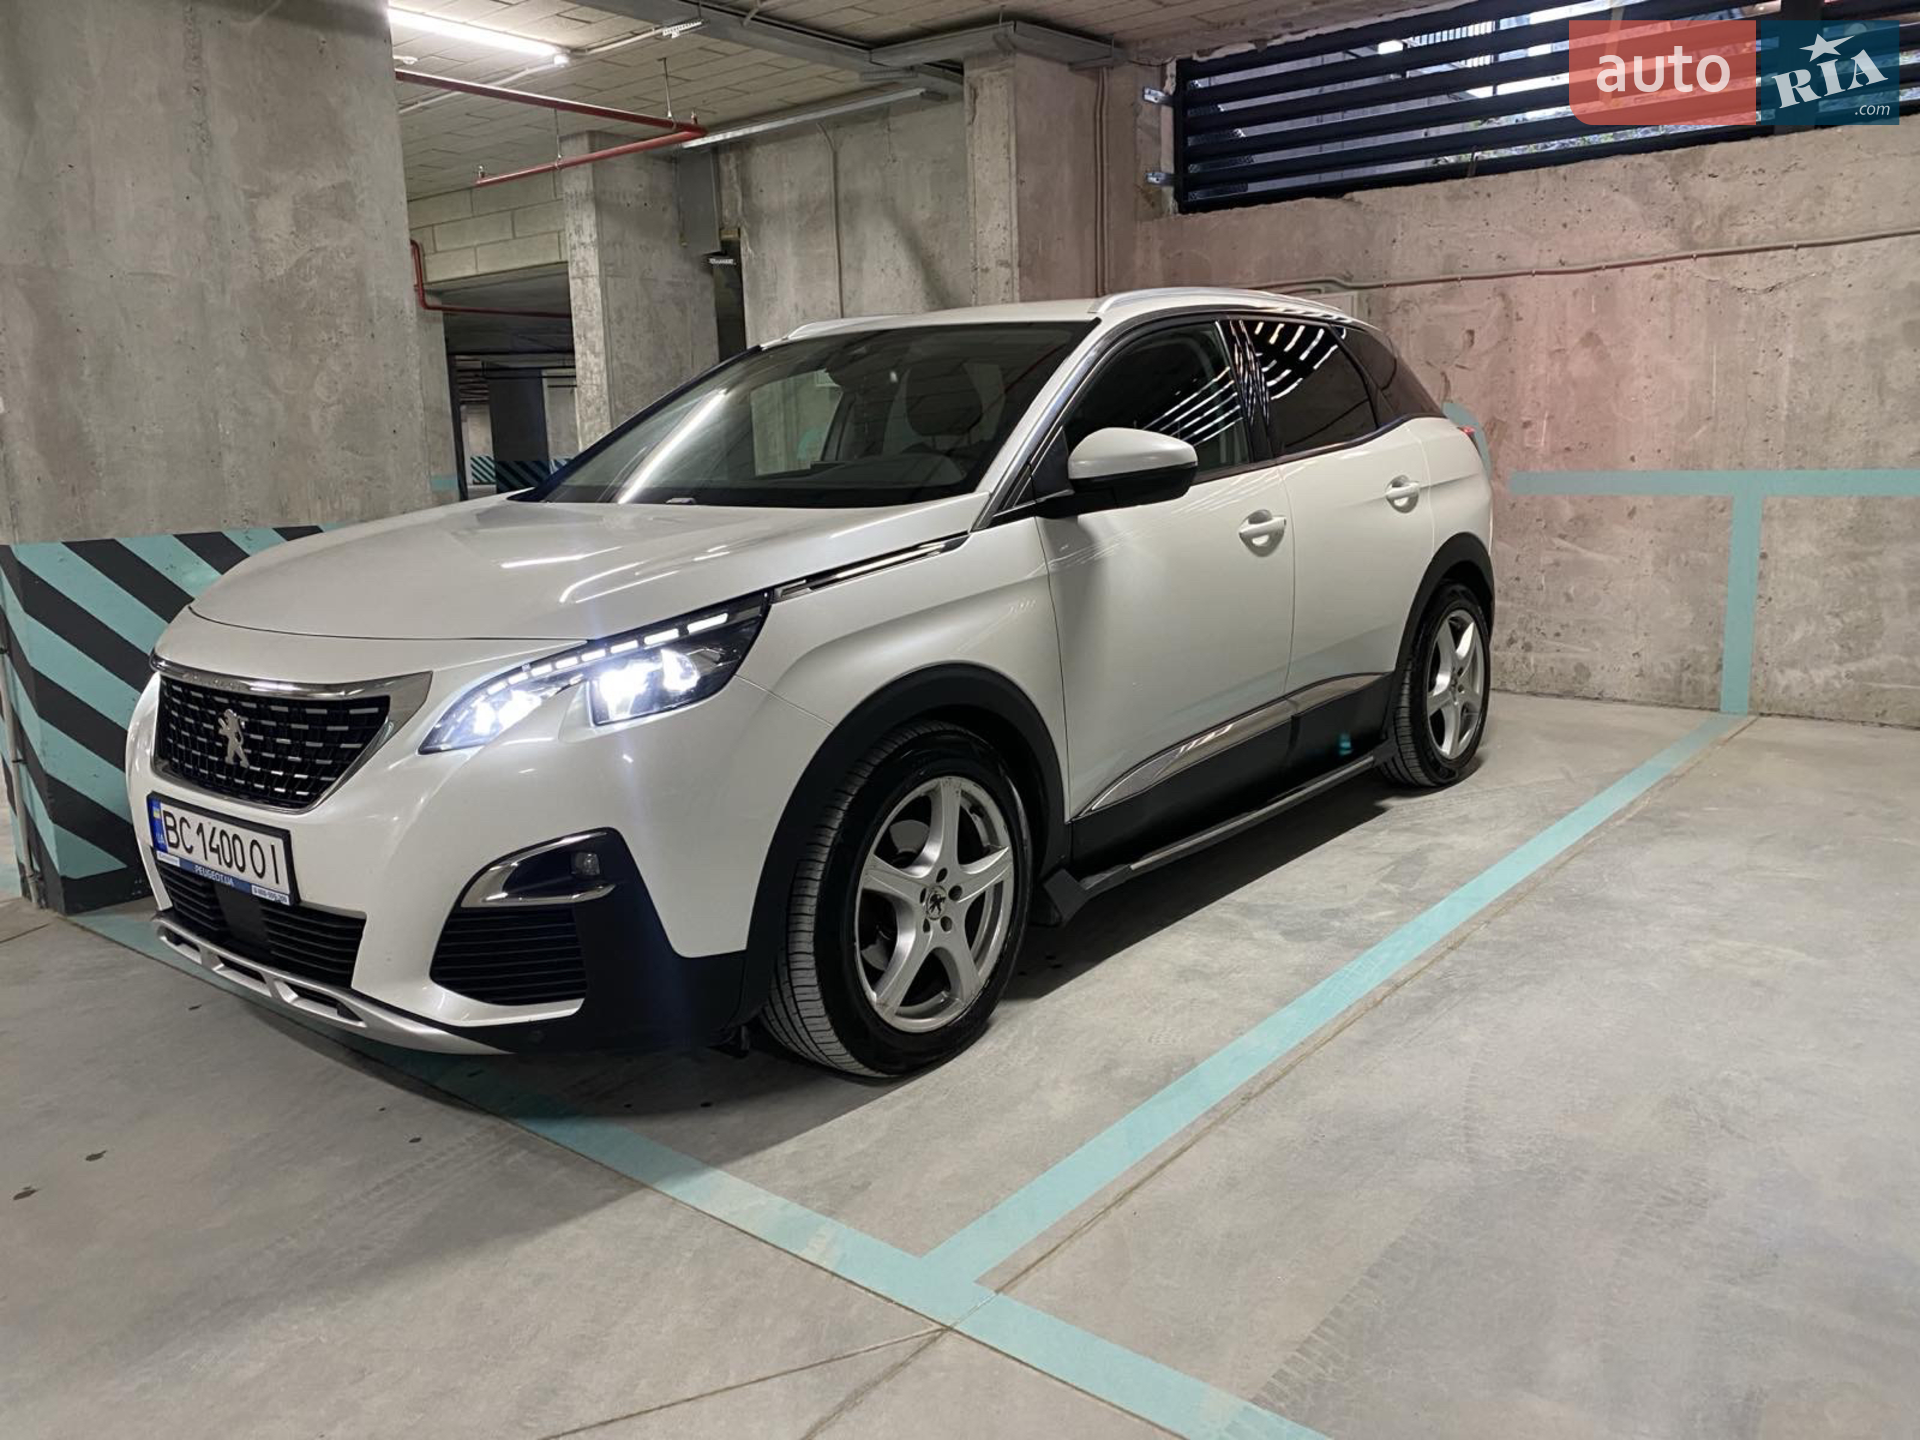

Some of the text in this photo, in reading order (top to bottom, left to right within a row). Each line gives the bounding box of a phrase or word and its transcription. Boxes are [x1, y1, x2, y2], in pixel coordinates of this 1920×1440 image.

[163, 810, 280, 885] BC 1400 OI
